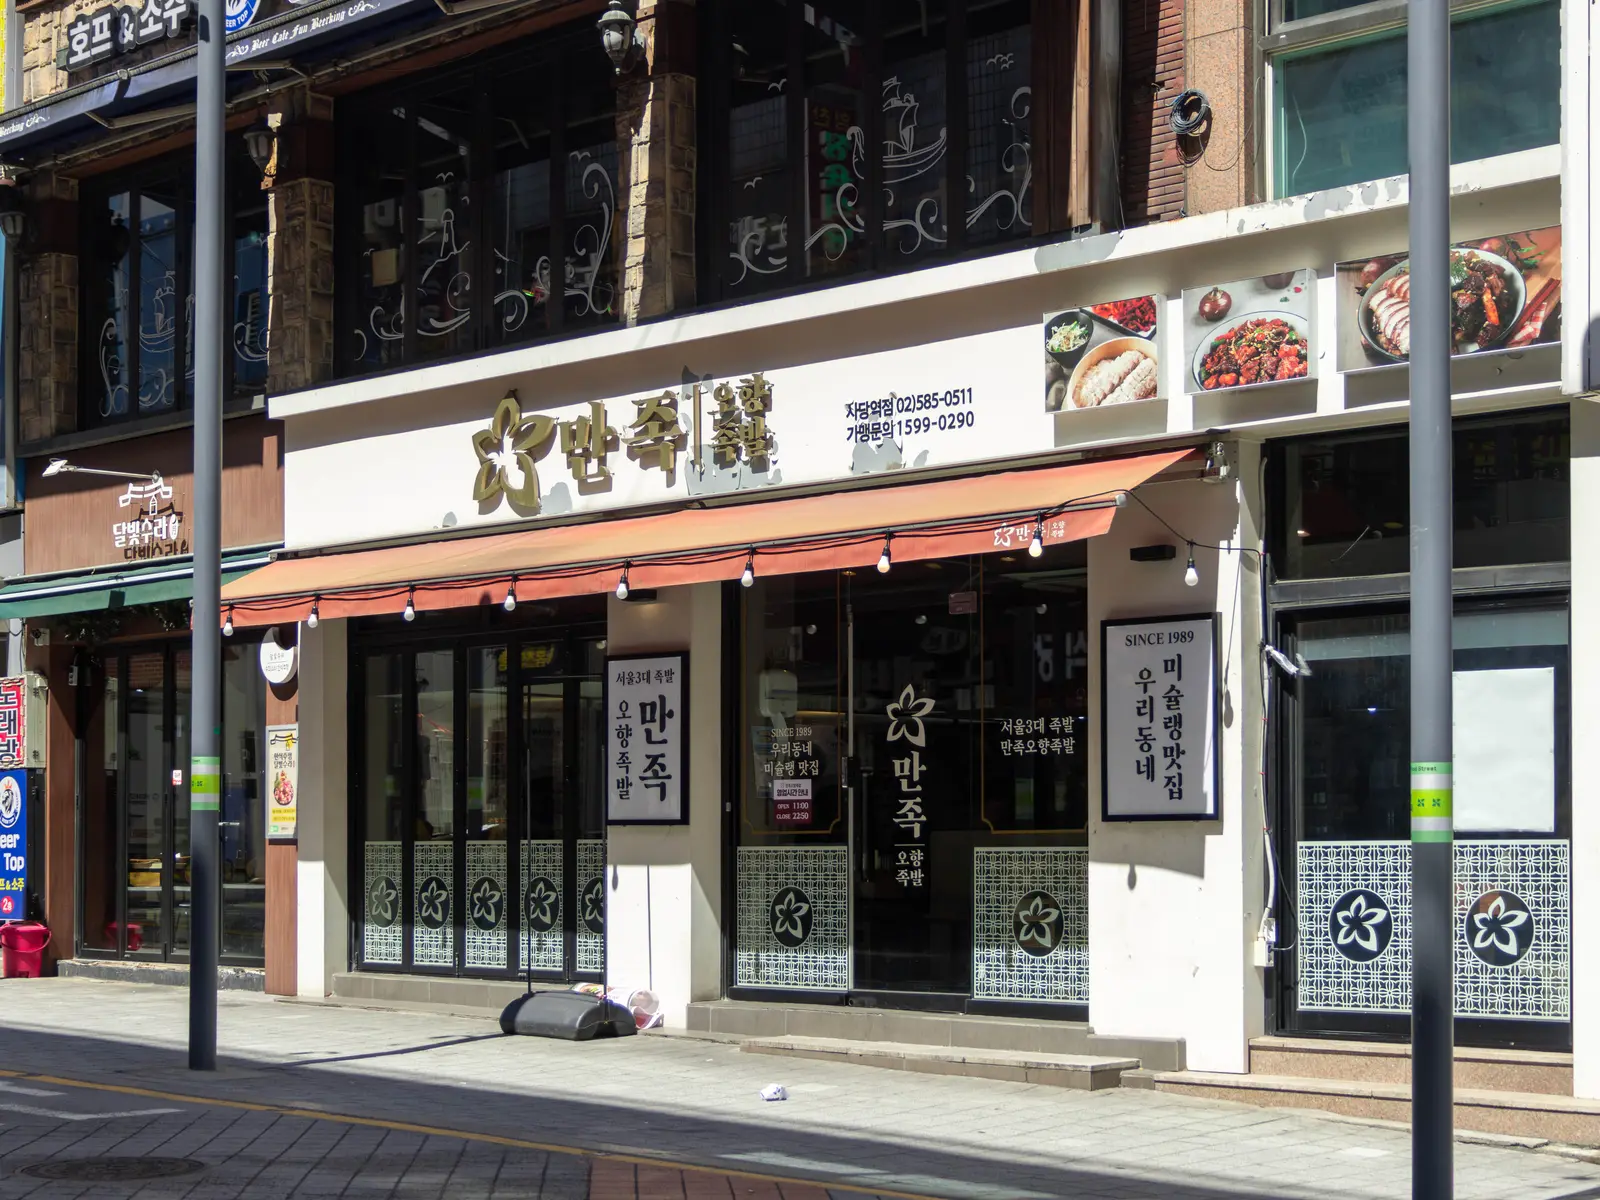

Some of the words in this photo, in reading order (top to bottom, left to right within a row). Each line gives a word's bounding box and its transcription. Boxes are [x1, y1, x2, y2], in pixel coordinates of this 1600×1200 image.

[226, 19, 237, 27] EER
[237, 10, 249, 25] TOP
[69, 12, 113, 64] 호프
[118, 12, 134, 44] &
[250, 38, 270, 52] Beer
[707, 372, 774, 415] 오향
[896, 387, 973, 414] 02)585-0511
[557, 390, 690, 481] 만족
[846, 419, 895, 443] 가맹문의
[898, 410, 975, 436] 1599-0290
[707, 415, 776, 463] 족발
[1125, 632, 1164, 647] SINCE
[1167, 630, 1194, 645] 1989
[615, 669, 651, 687] 서울3대
[653, 668, 675, 685] 족발
[771, 727, 794, 738] SINCE
[796, 726, 812, 737] 1989
[1000, 717, 1045, 736] 서울3대
[1048, 716, 1075, 734] 족발
[1134, 667, 1156, 783] 우리동네
[1162, 653, 1186, 800] 미슐랭맛집
[615, 700, 633, 800] 오향족발
[638, 694, 675, 802] 만족
[771, 740, 812, 758] 우리동네
[1000, 736, 1076, 757] 만족오향족발
[764, 761, 795, 777] 미슐랭
[798, 760, 819, 776] 맛집
[892, 750, 927, 838] 만족
[792, 812, 809, 820] 22:50
[793, 802, 809, 810] 11:00
[0, 833, 20, 848] eer
[4, 852, 25, 872] Top
[896, 849, 924, 867] 오향
[896, 868, 925, 887] 족발
